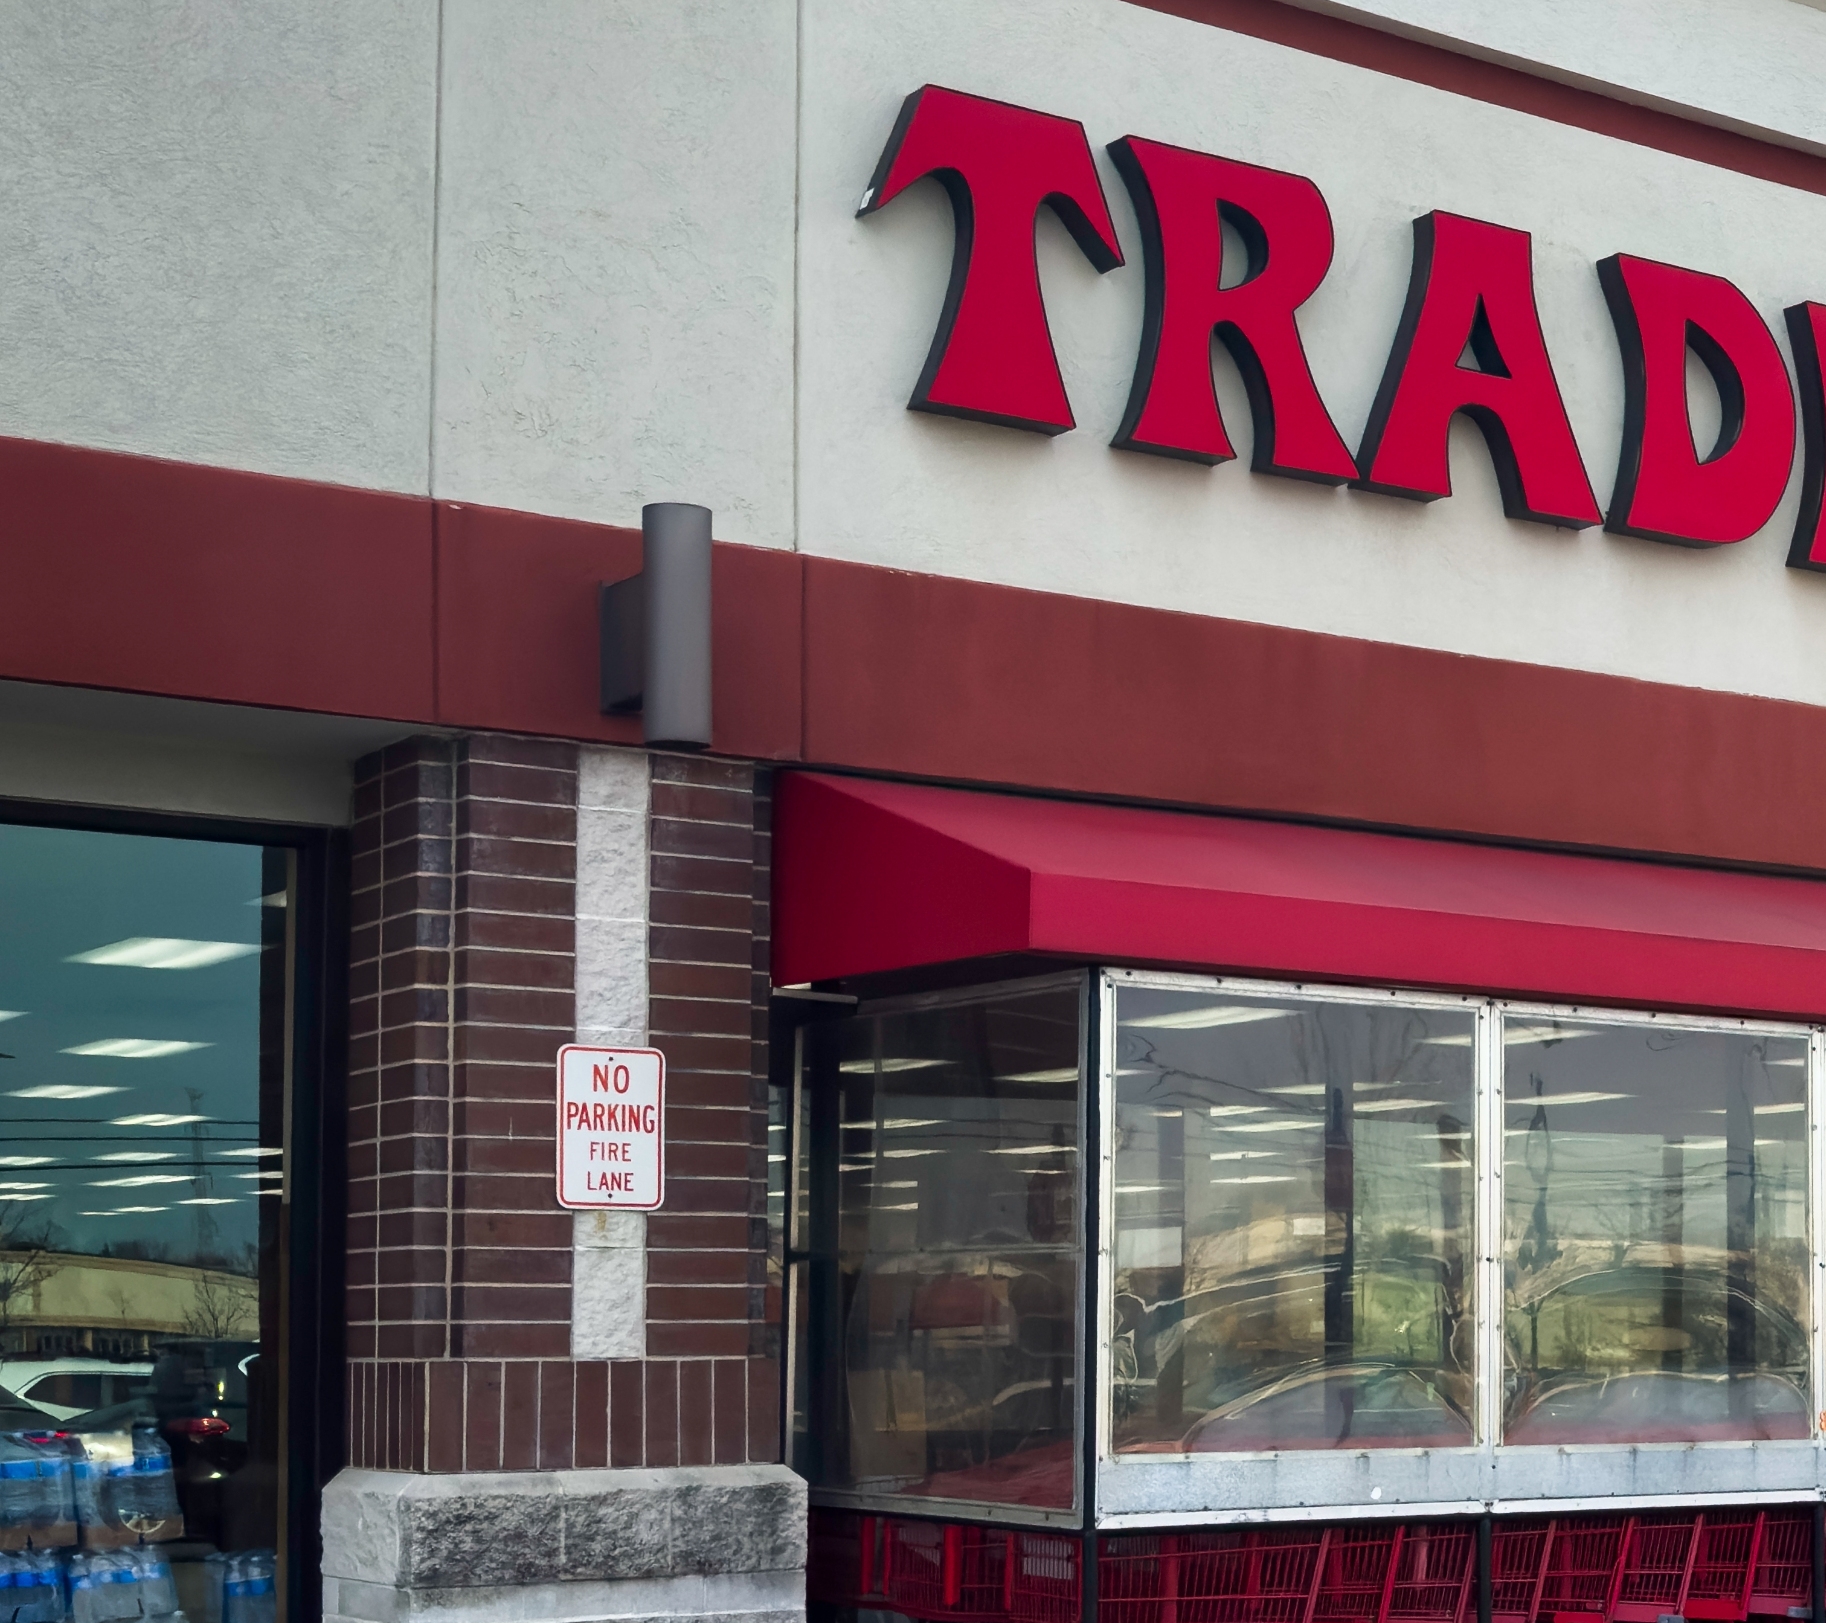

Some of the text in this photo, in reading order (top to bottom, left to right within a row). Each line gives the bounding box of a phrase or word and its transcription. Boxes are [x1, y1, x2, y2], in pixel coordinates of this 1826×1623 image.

[593, 1064, 630, 1094] NO
[567, 1102, 655, 1134] PARKING
[590, 1142, 631, 1162] FIRE
[587, 1171, 634, 1192] LANE
